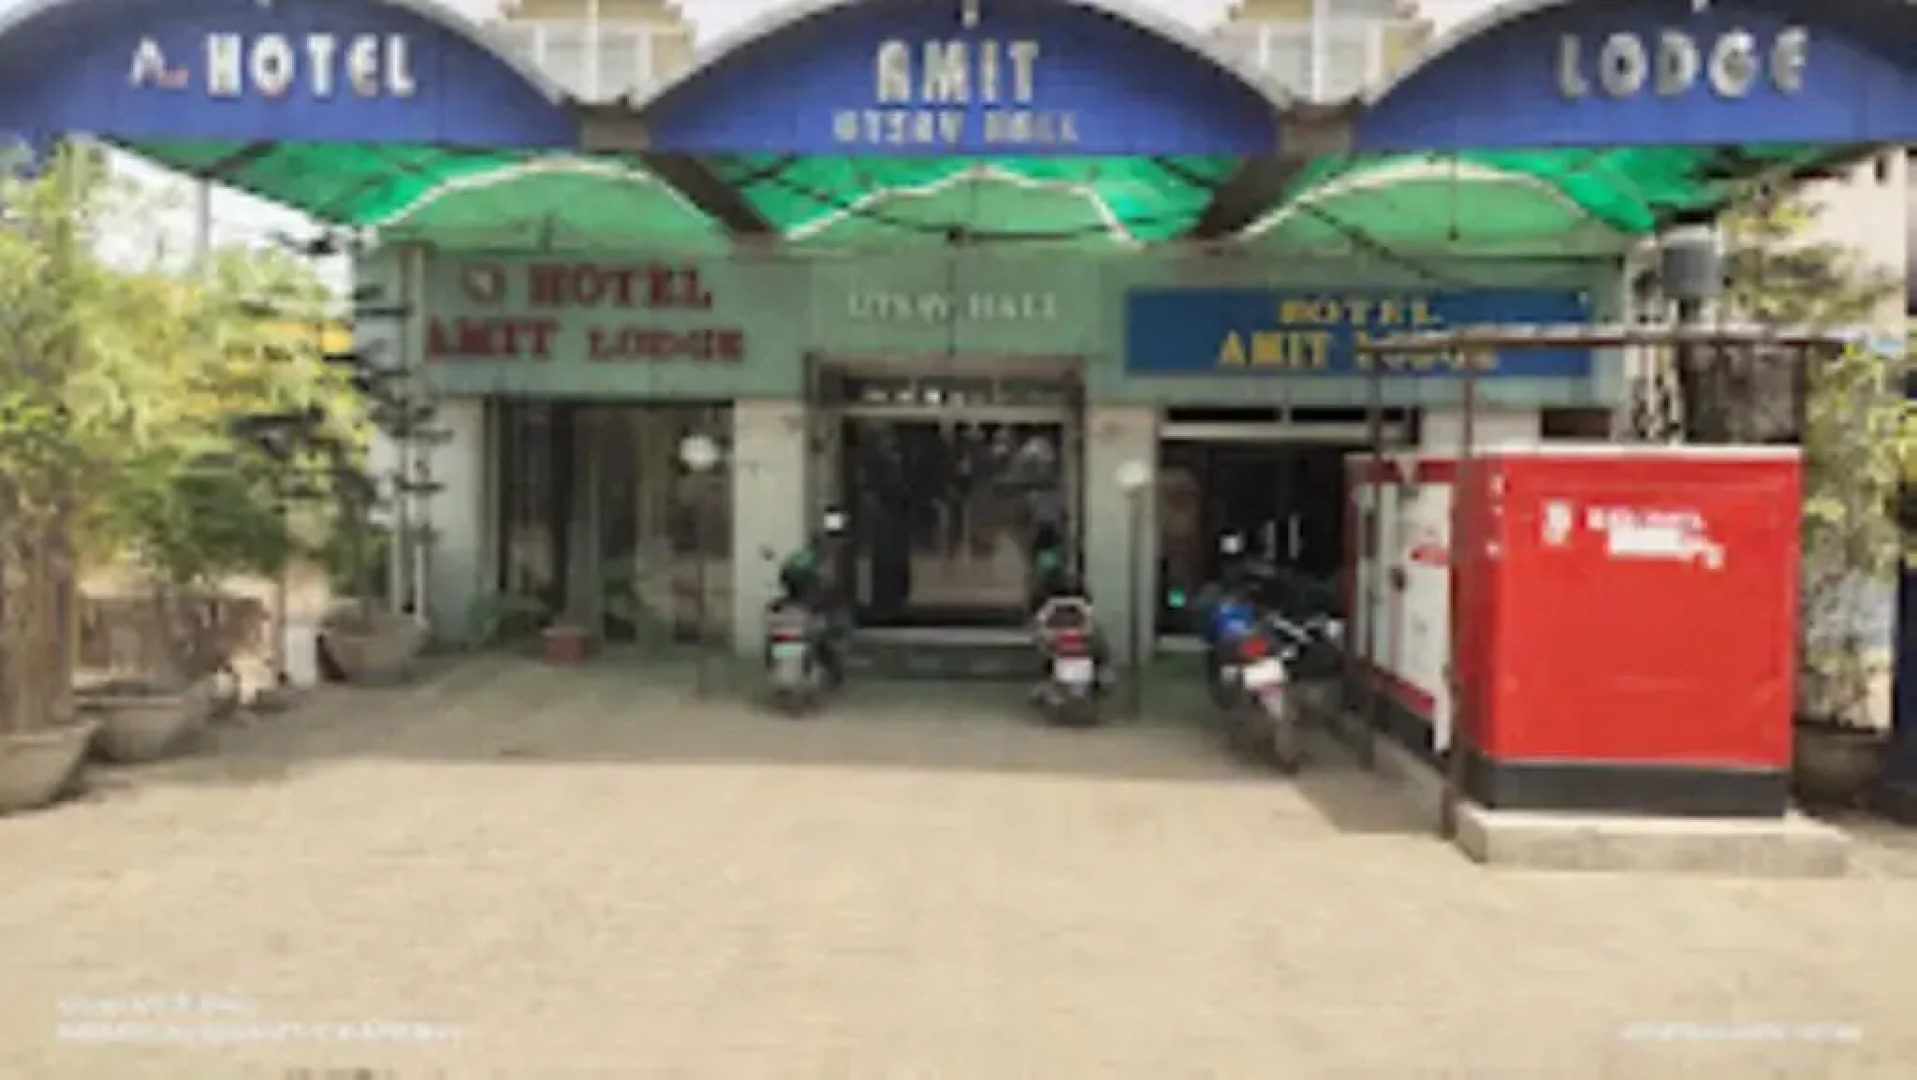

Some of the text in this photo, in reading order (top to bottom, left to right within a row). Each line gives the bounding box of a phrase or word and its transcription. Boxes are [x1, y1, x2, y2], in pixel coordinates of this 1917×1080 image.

[207, 33, 416, 96] HOTEL
[876, 40, 1040, 103] AMIT
[1558, 27, 1809, 97] LODGE
[529, 263, 713, 309] HOTEL
[1277, 299, 1440, 325] HOTEL
[425, 316, 746, 363] AMIT LODGE
[1217, 329, 1332, 370] AMIT
